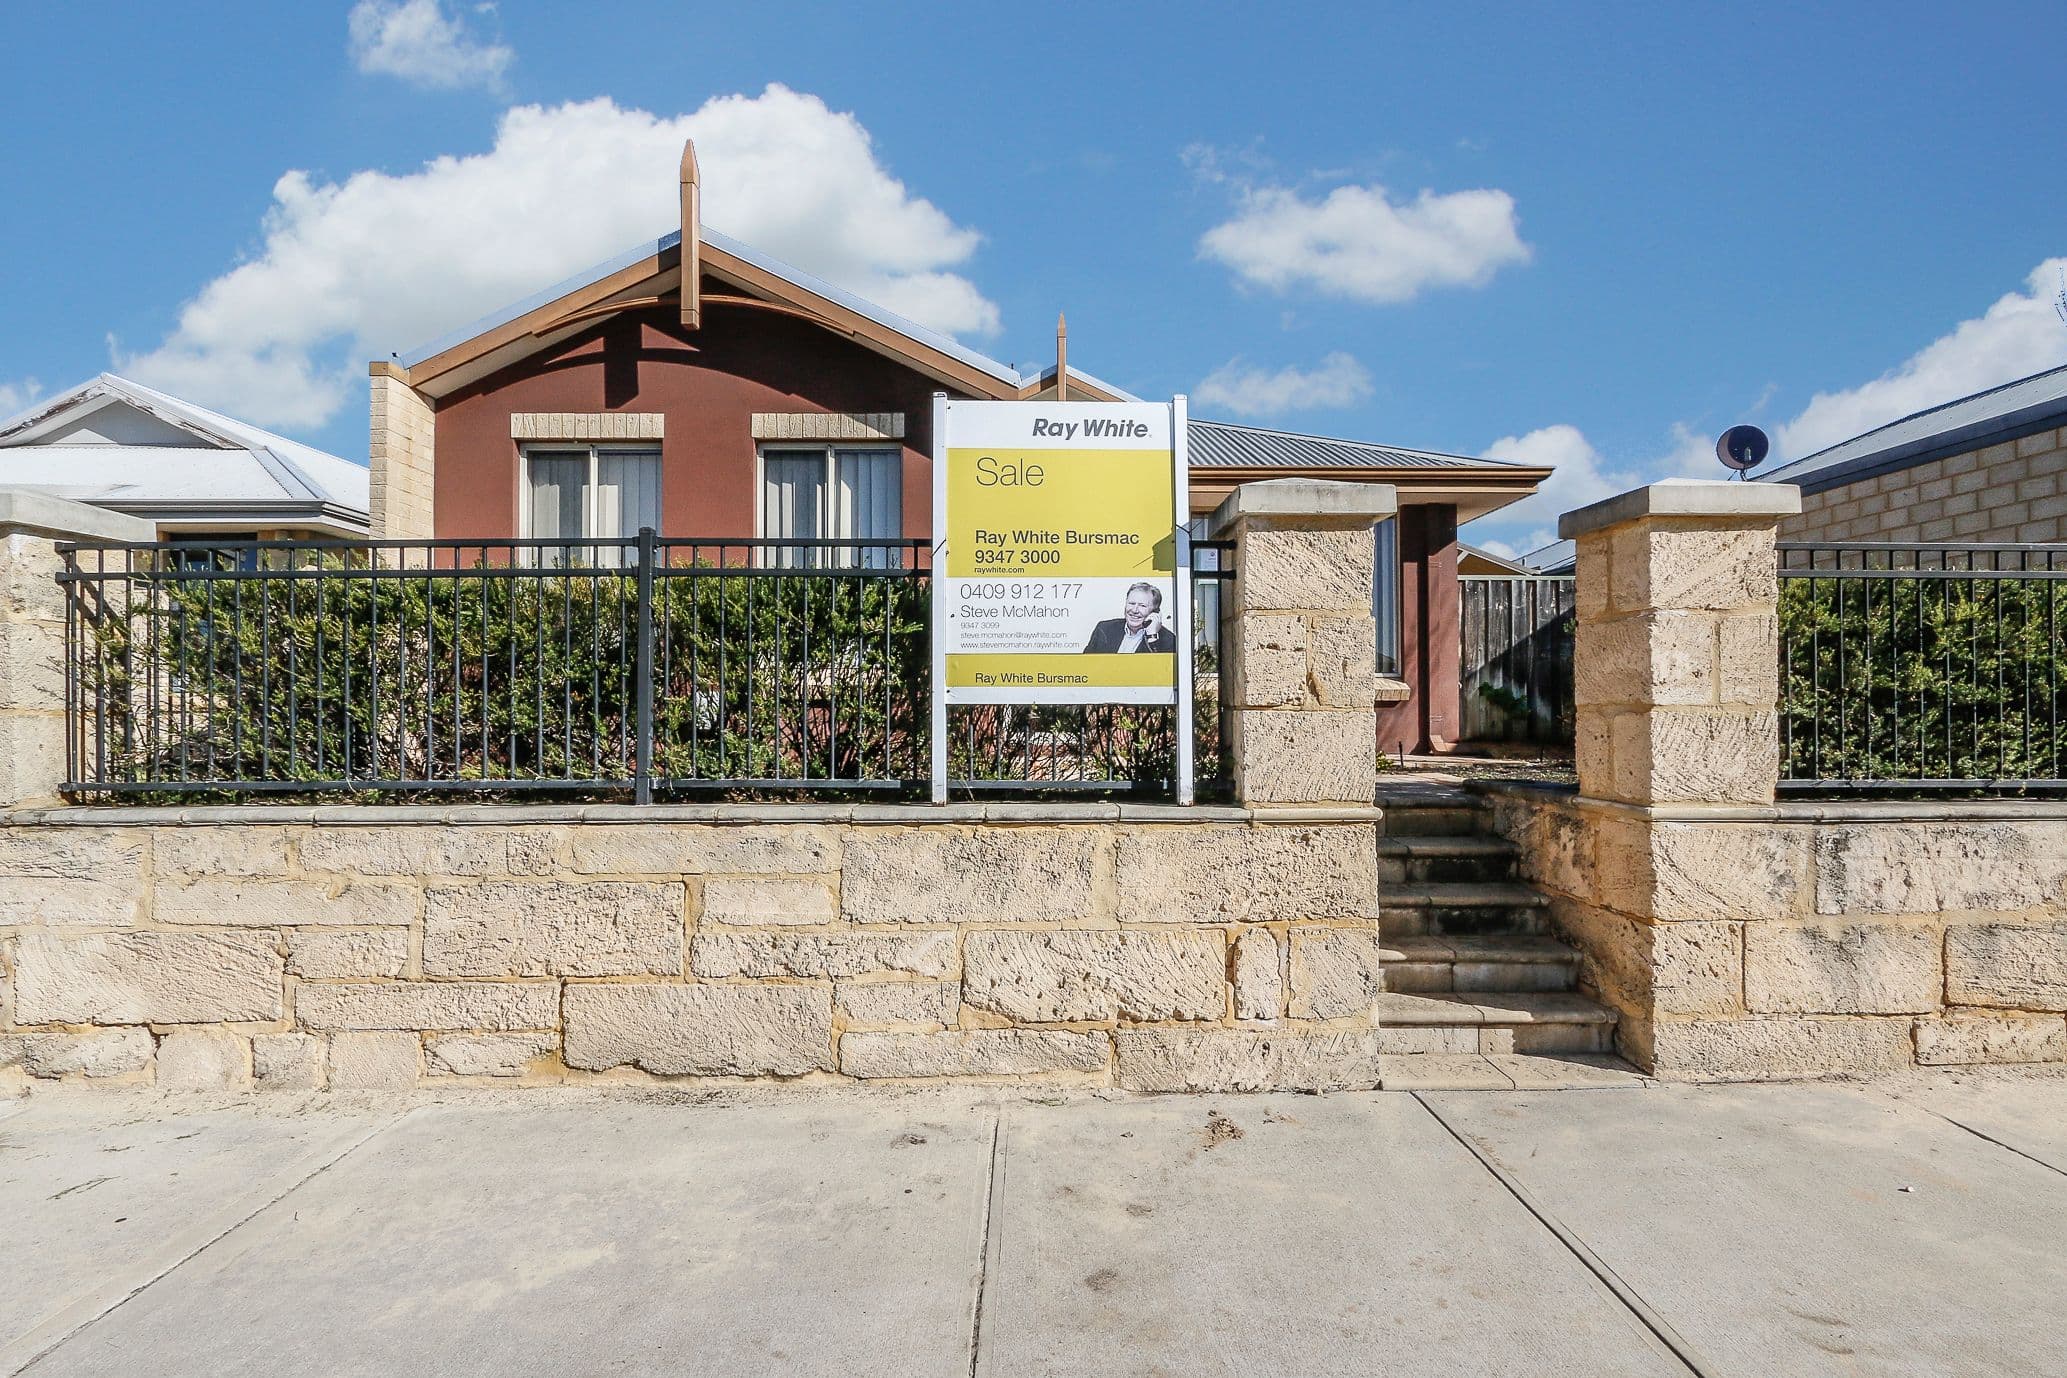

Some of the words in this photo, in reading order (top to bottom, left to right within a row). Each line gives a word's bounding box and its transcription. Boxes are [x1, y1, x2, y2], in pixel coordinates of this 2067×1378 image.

[1032, 418, 1079, 440] Ray
[1084, 419, 1149, 438] White
[976, 457, 1044, 486] Sale
[975, 530, 1007, 547] Ray
[1012, 530, 1060, 544] White
[1065, 530, 1139, 545] Bursmac
[975, 550, 1014, 564] 9347
[1020, 550, 1060, 564] 3000
[974, 565, 1025, 575] raywhite.com
[960, 583, 1005, 599] 0409
[1011, 583, 1044, 599] 912
[1051, 583, 1083, 599] 177
[960, 605, 999, 618] Steve
[1002, 605, 1070, 618] McMahon
[975, 673, 998, 686] Ray
[1001, 673, 1034, 684] White
[1037, 673, 1089, 684] Bursmac
